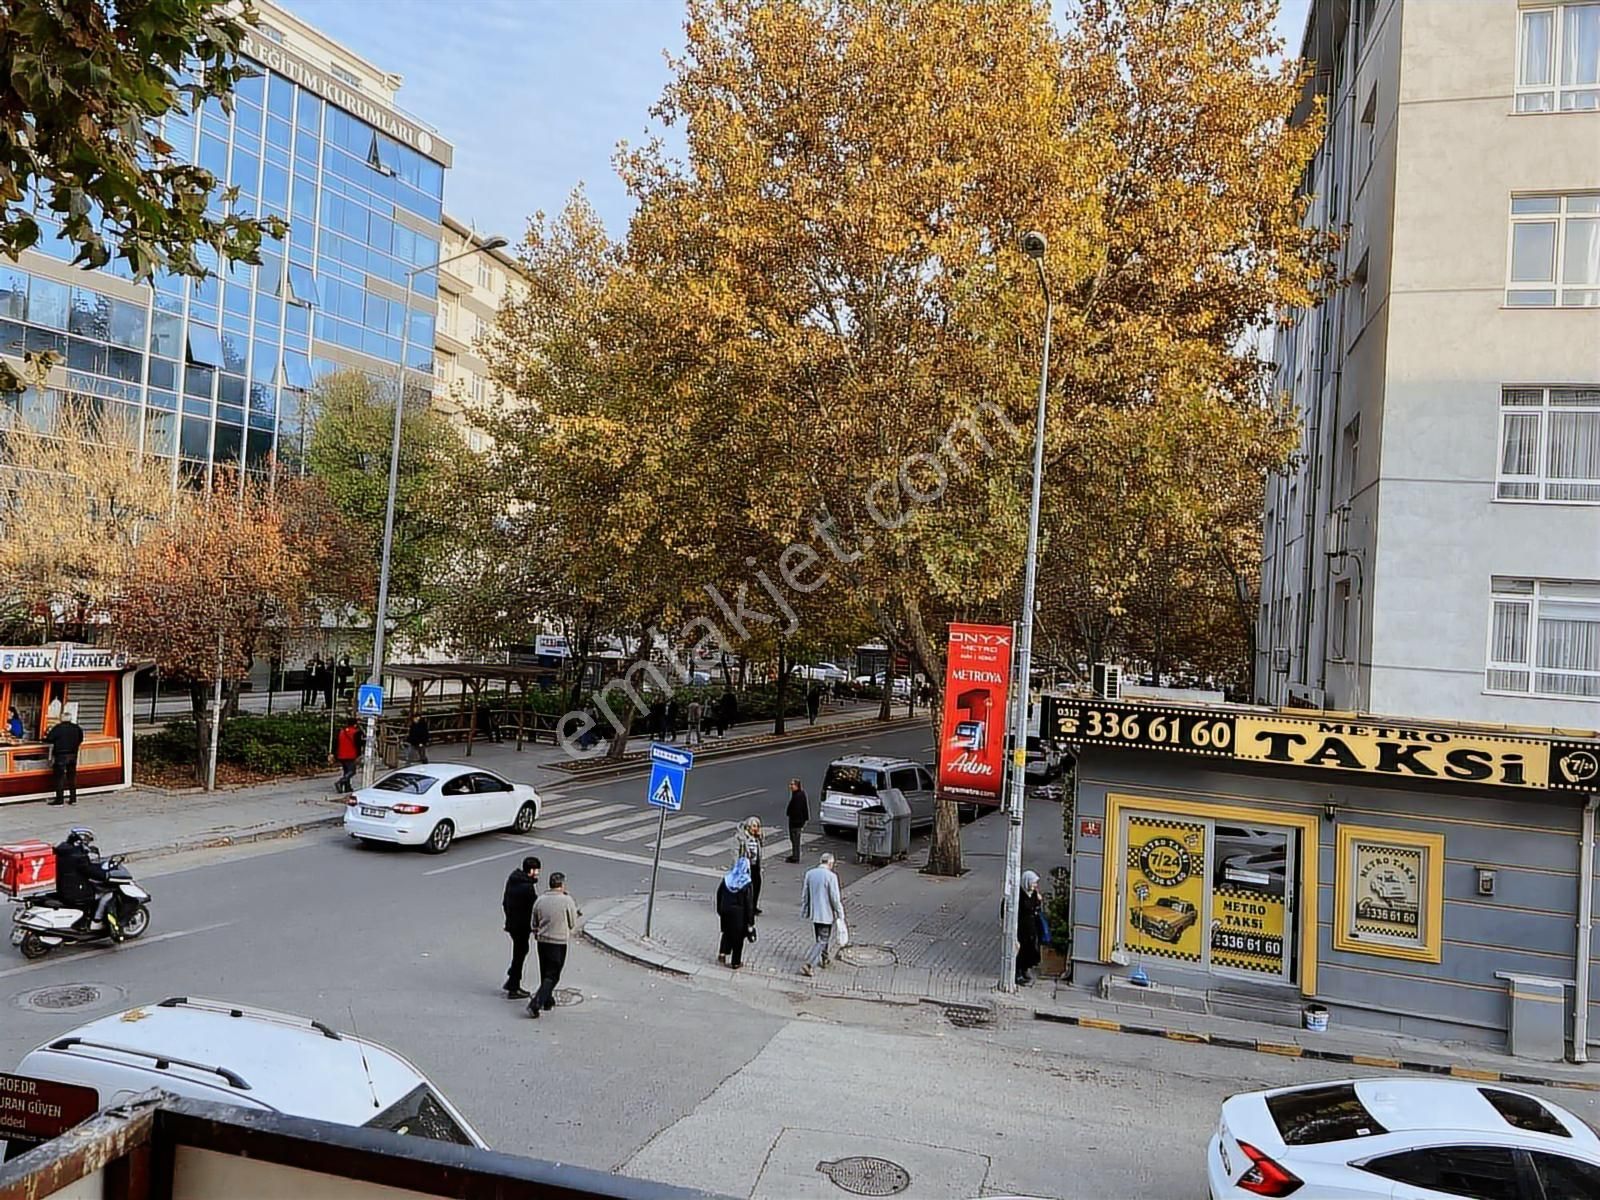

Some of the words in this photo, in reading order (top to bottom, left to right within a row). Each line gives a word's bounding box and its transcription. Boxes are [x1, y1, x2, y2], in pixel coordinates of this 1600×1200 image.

[259, 43, 319, 92] EĞİTİM
[322, 80, 414, 144] KURUMLARI
[949, 632, 1010, 646] ONYX
[16, 657, 52, 668] HALK
[71, 655, 113, 668] EKMEK
[952, 669, 1002, 683] METROYA
[1057, 708, 1080, 717] 0312
[1086, 711, 1141, 740] 336
[1148, 716, 1180, 744] 61
[1191, 720, 1231, 749] 60
[1318, 722, 1451, 743] METRO
[1150, 851, 1181, 868] 7/24
[1223, 900, 1266, 916] METRO
[1222, 934, 1244, 949] 336
[1247, 938, 1261, 952] 61
[1265, 941, 1281, 955] 60
[28, 1100, 62, 1118] GÜVEN
